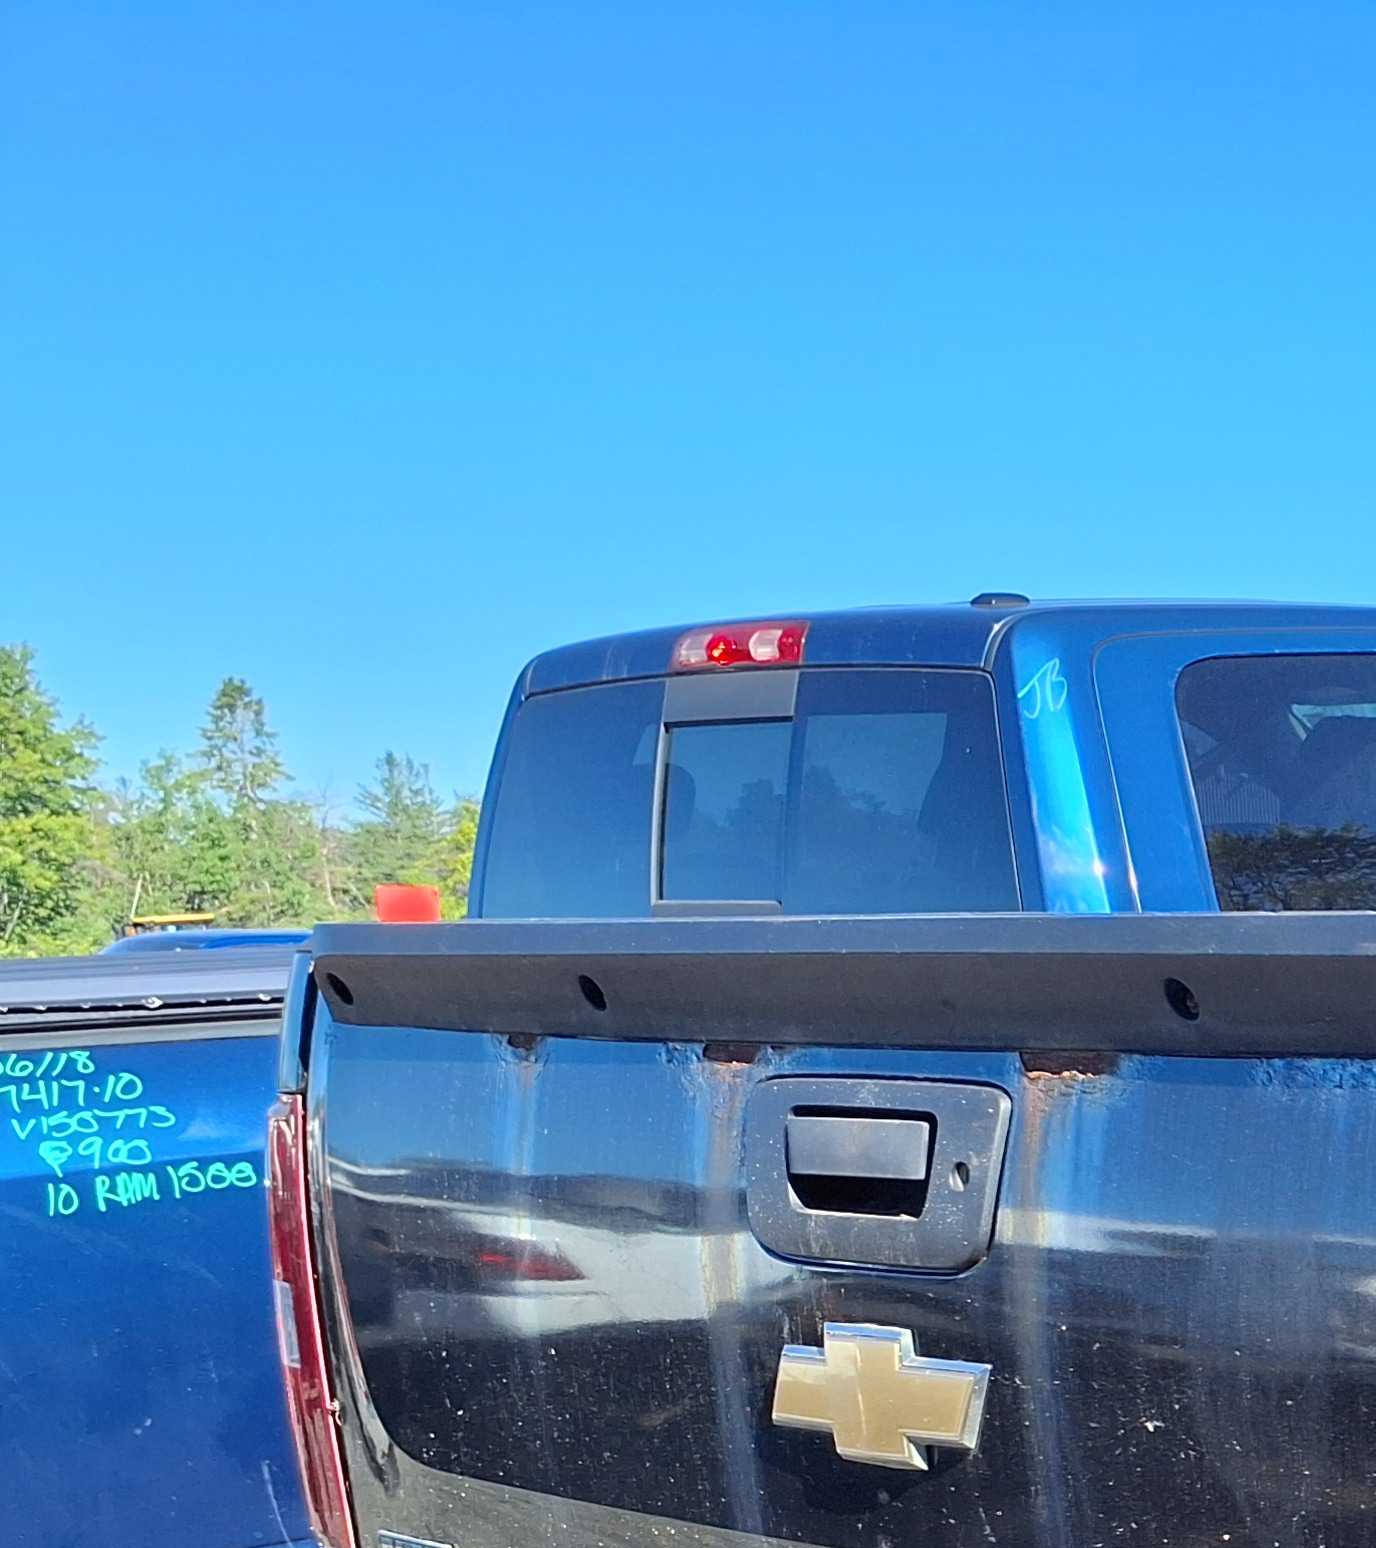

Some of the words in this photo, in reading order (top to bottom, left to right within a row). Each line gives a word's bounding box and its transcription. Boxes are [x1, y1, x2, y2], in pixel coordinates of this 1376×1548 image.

[1017, 657, 1068, 719] JB
[48, 1183, 79, 1217] 10
[95, 1172, 160, 1212] RAM
